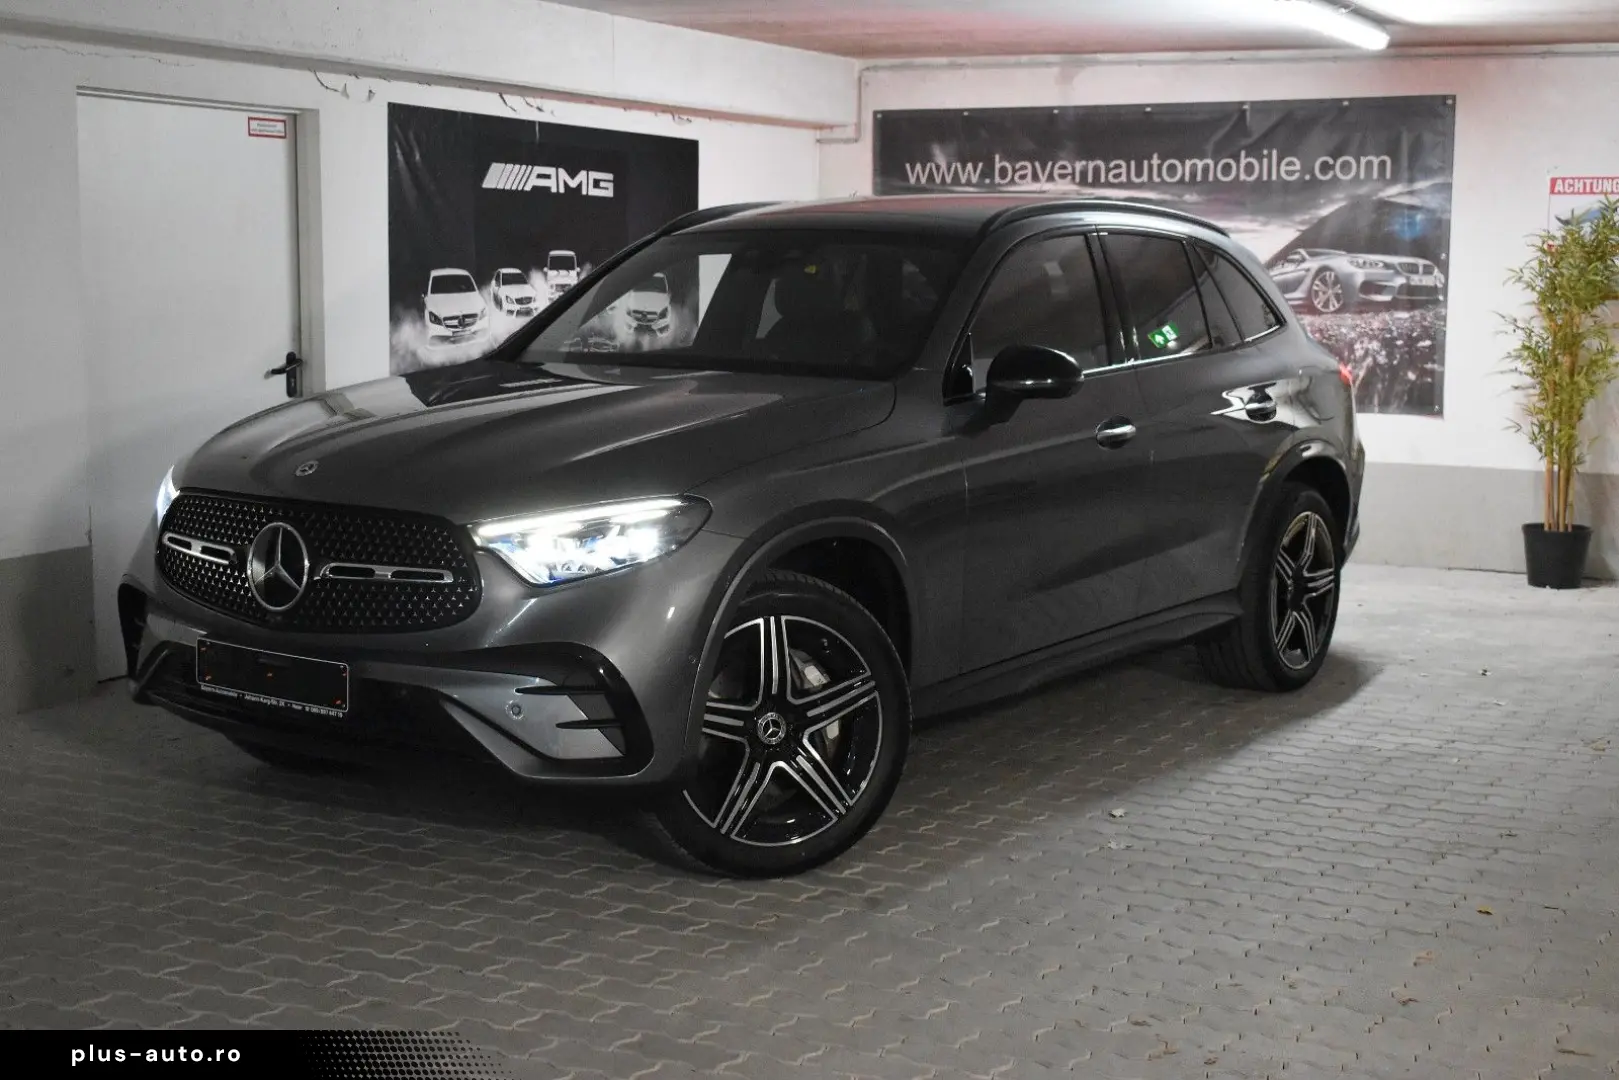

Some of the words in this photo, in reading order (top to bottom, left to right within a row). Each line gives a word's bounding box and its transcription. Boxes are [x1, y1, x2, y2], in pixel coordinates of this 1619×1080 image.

[523, 165, 614, 198] AMG
[905, 149, 1391, 190] www.bayernautomobile.com
[1554, 178, 1619, 193] ACHTUNG
